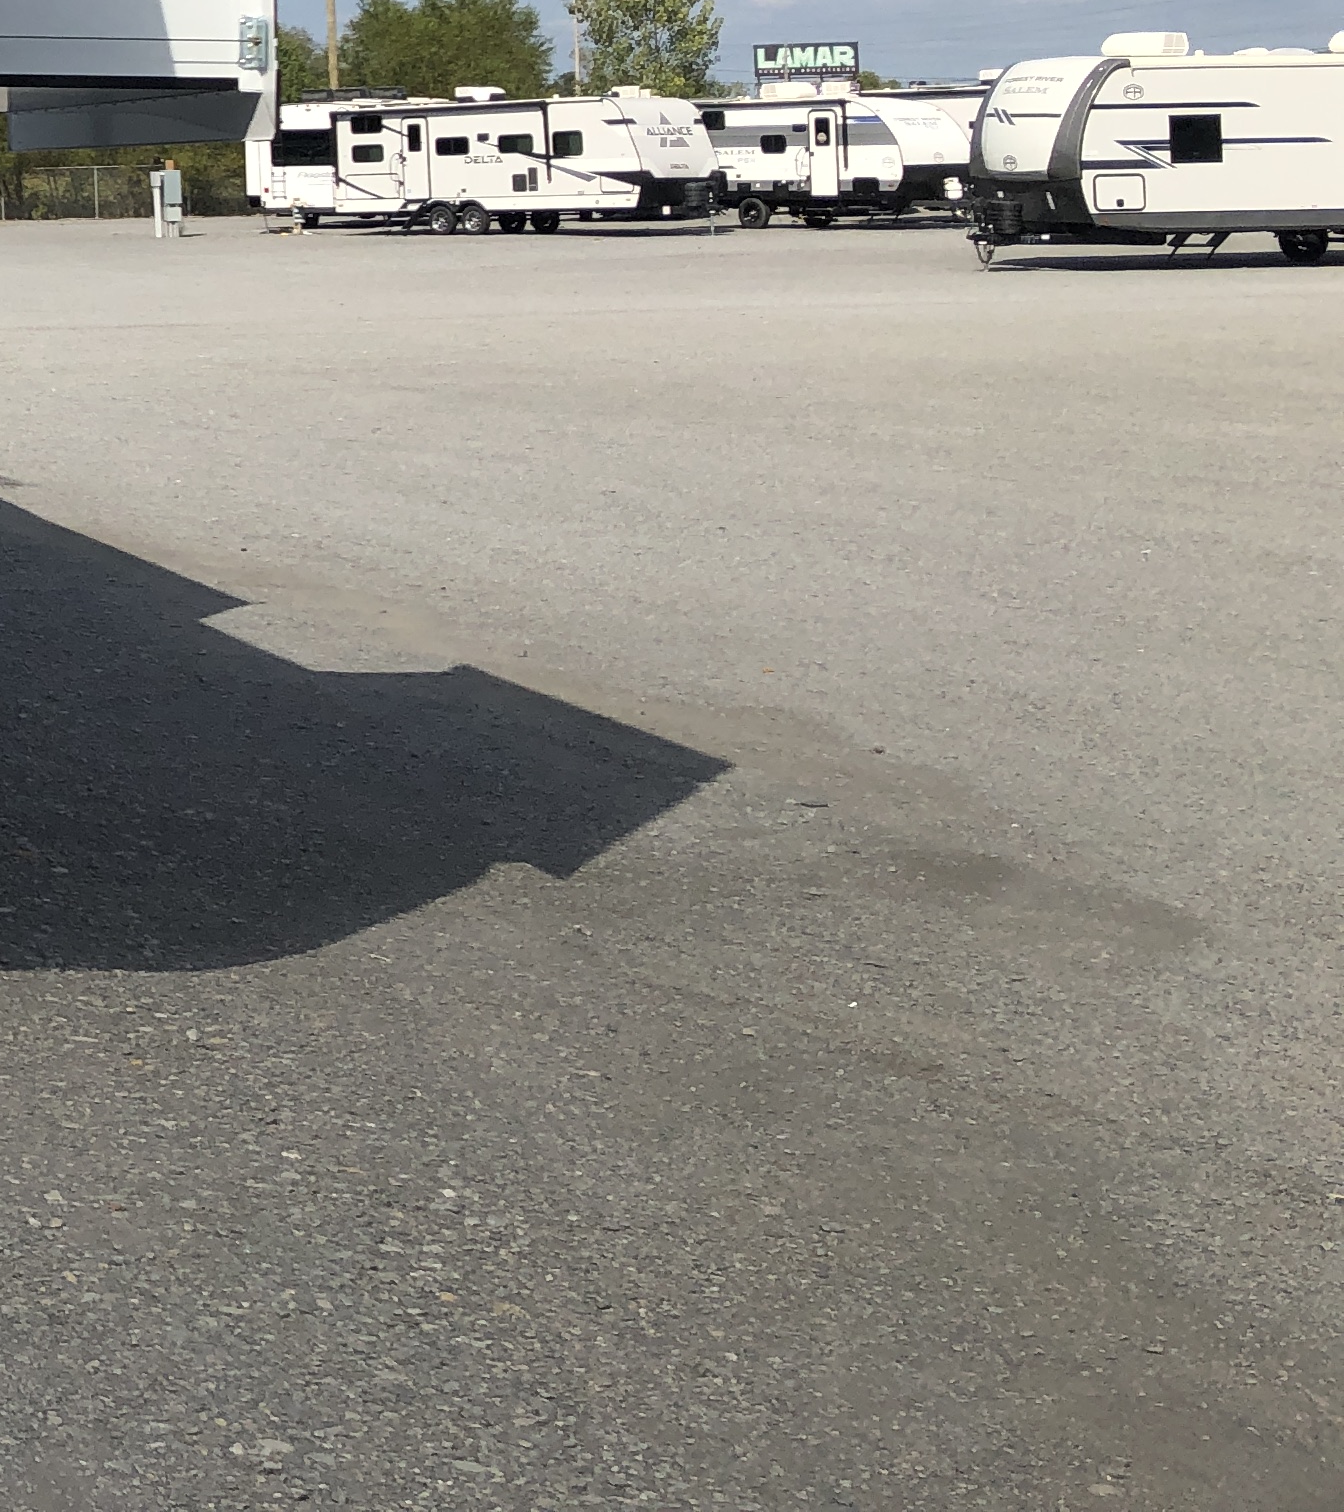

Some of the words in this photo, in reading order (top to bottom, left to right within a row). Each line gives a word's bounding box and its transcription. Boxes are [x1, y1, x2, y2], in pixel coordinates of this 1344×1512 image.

[756, 46, 855, 68] LAMAR
[646, 126, 694, 136] ALLIANCE
[464, 155, 503, 164] DELTA
